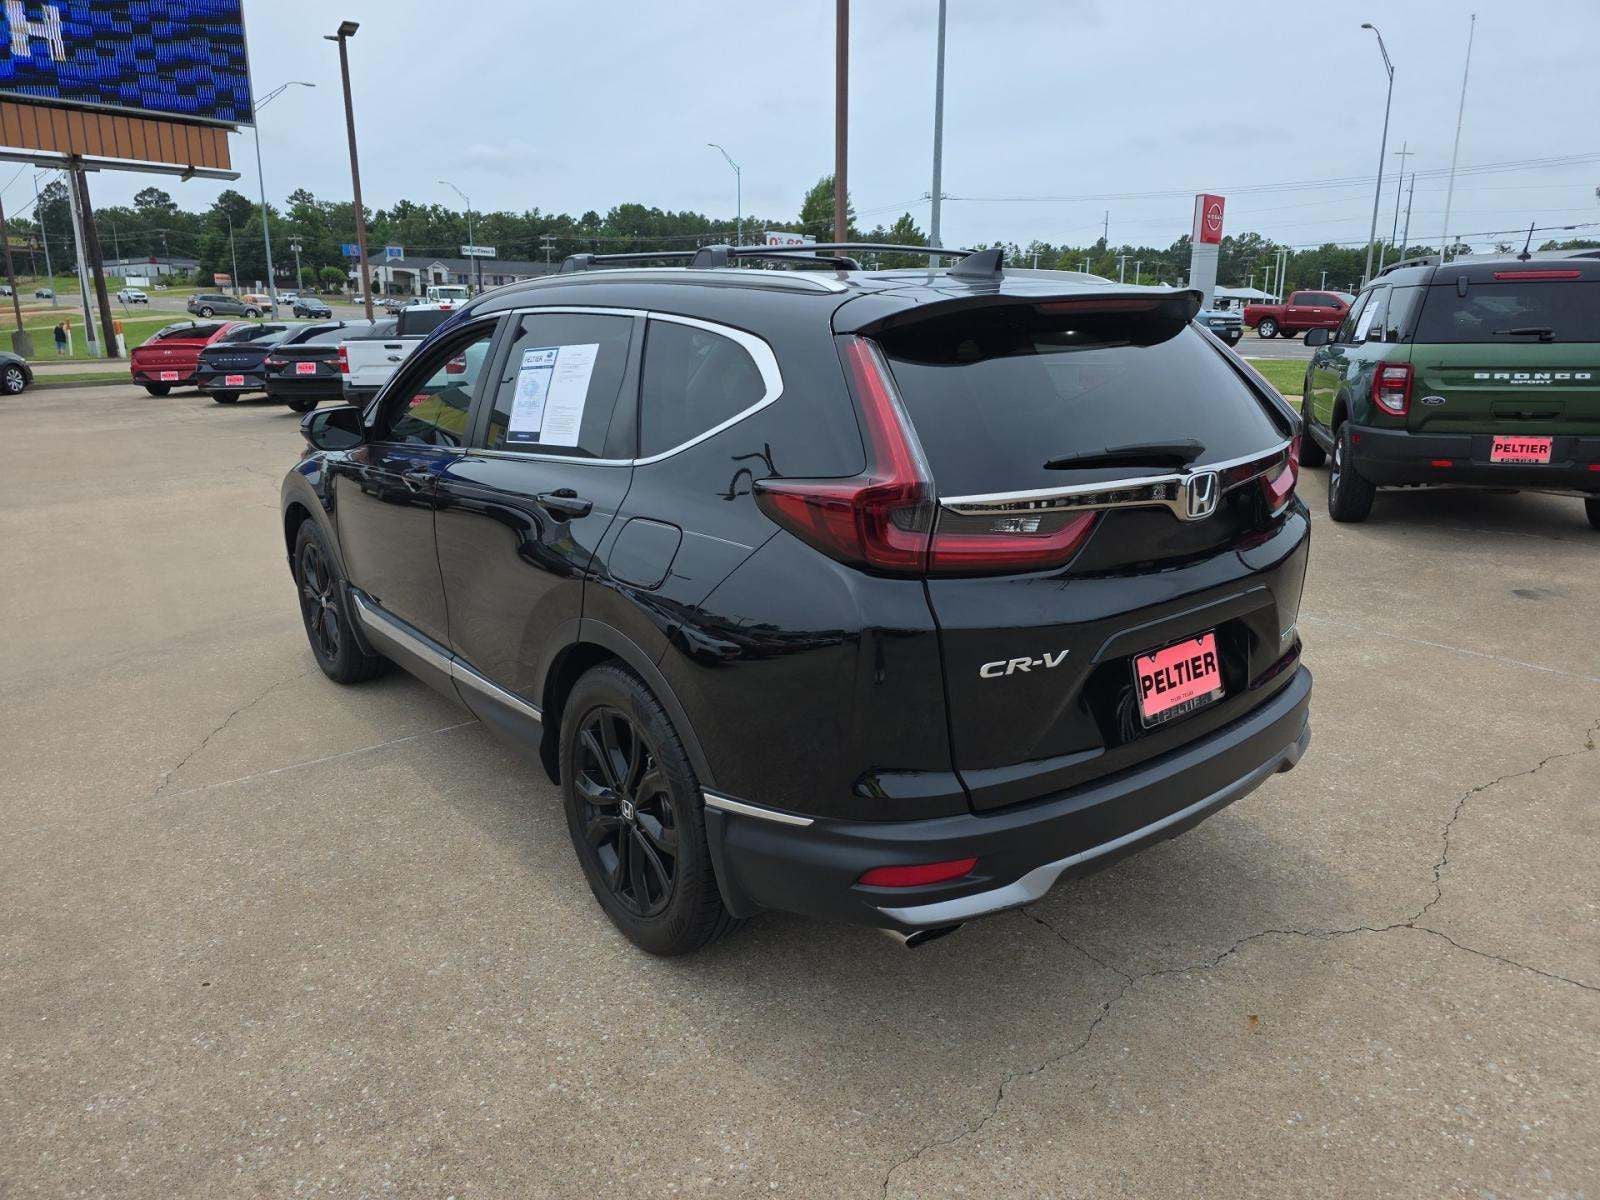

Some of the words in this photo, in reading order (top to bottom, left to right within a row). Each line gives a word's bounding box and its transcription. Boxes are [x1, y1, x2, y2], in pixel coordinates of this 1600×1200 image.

[1473, 372, 1591, 380] BRONCO
[1494, 443, 1548, 454] PELTIER
[979, 649, 1070, 679] CR-V
[1140, 651, 1217, 700] PELTIER
